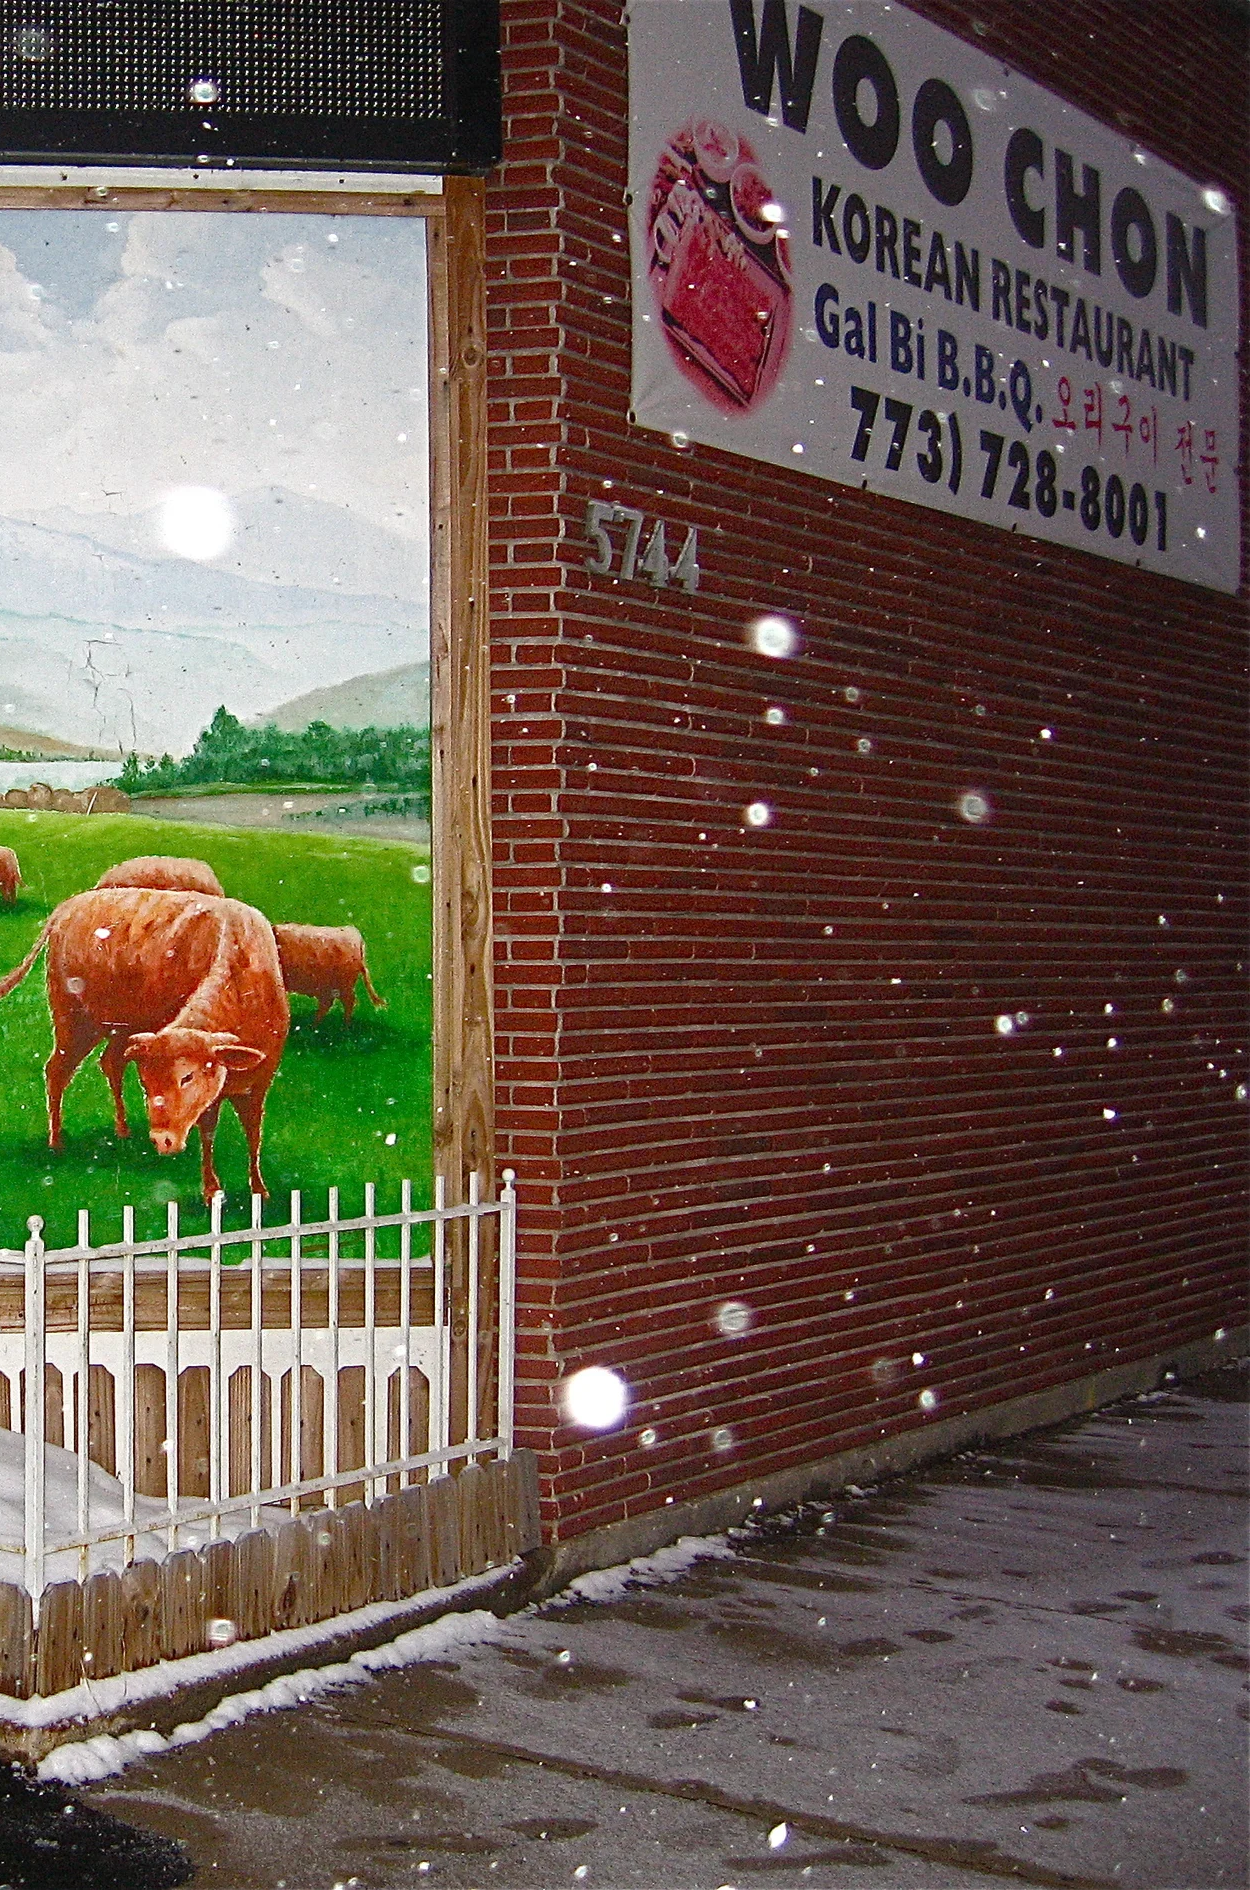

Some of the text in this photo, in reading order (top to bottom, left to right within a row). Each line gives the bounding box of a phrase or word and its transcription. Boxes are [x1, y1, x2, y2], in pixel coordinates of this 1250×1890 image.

[729, 0, 1207, 329] WOO CHON
[812, 175, 1195, 401] KOREAN RESTAURANT
[814, 282, 1044, 433] Gal Bi B.B.Q.
[850, 385, 1168, 552] 773) 728-8001
[1052, 376, 1220, 494] 오리구이 전문
[584, 499, 700, 596] 5744
